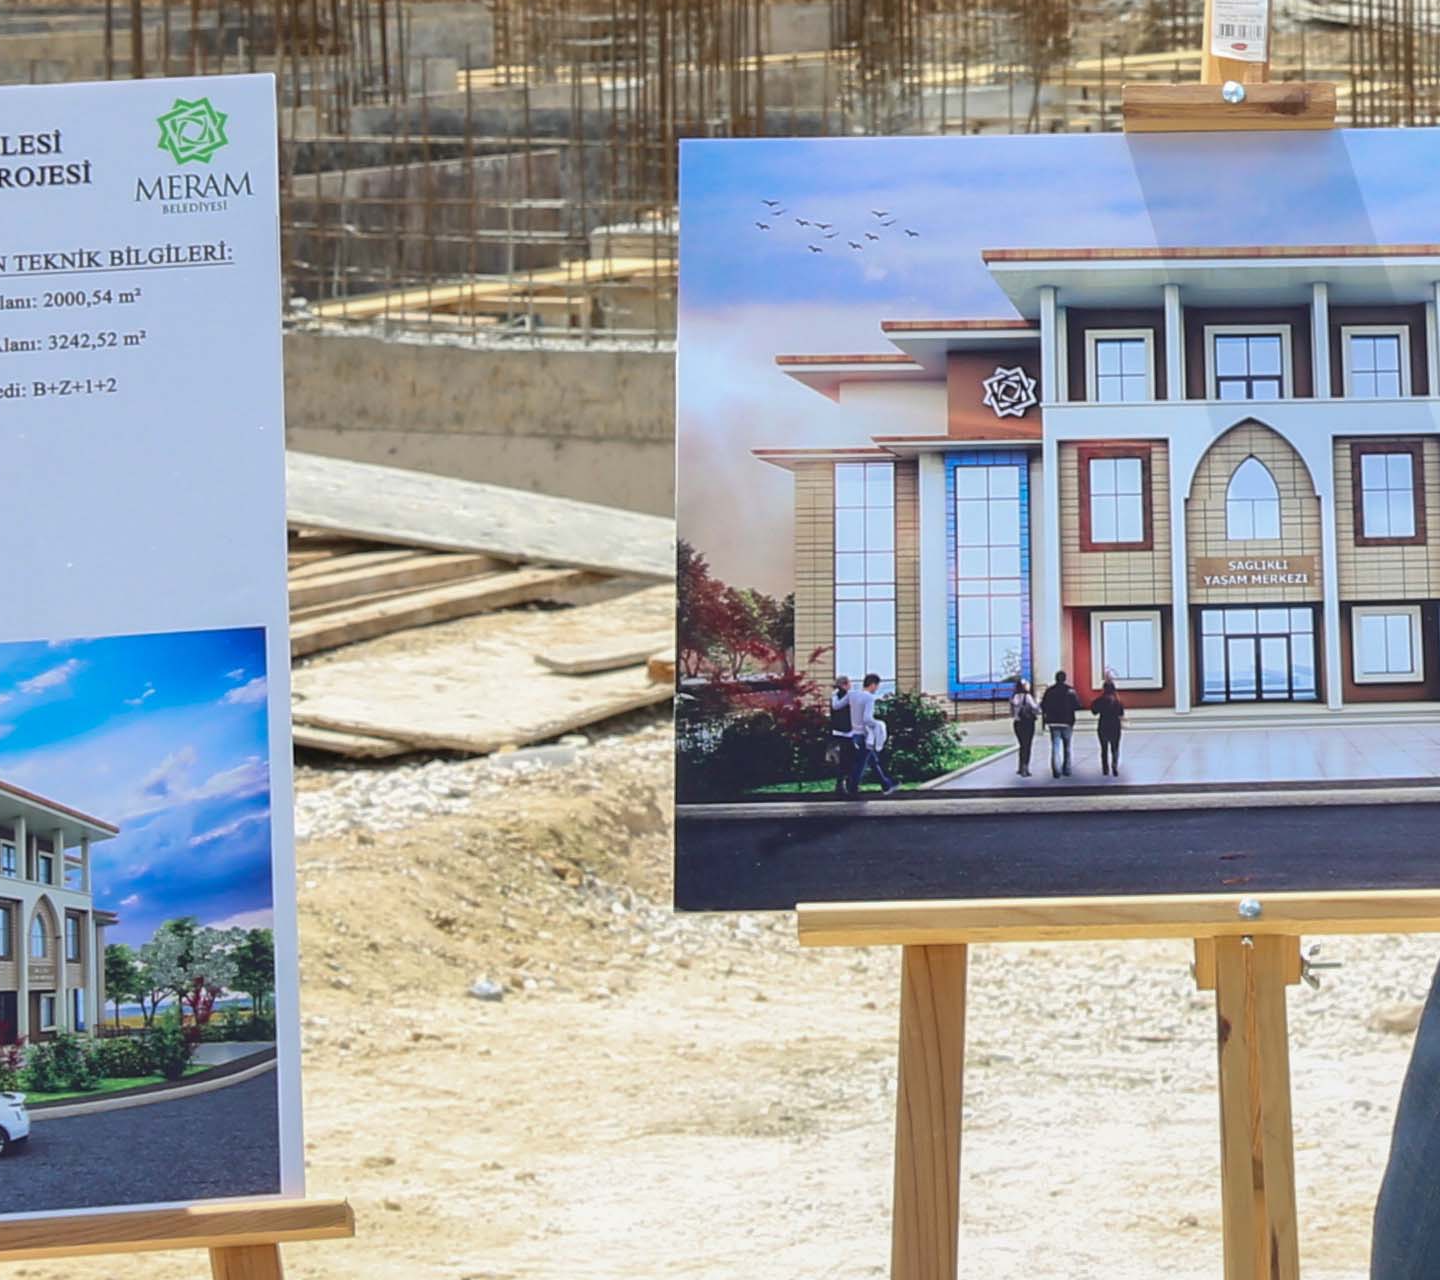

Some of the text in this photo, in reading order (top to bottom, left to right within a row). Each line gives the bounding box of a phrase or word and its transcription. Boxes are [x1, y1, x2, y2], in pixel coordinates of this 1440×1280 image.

[134, 171, 254, 202] MERAM
[162, 199, 228, 215] BELEDİYESİ
[13, 247, 104, 272] TEKNİK
[109, 239, 233, 267] BİLGİLERİ:
[43, 289, 113, 309] 2000,54
[118, 287, 142, 304] m²
[47, 332, 118, 352] 3242,52
[123, 330, 147, 347] m²
[33, 377, 118, 397] B+Z+1+2
